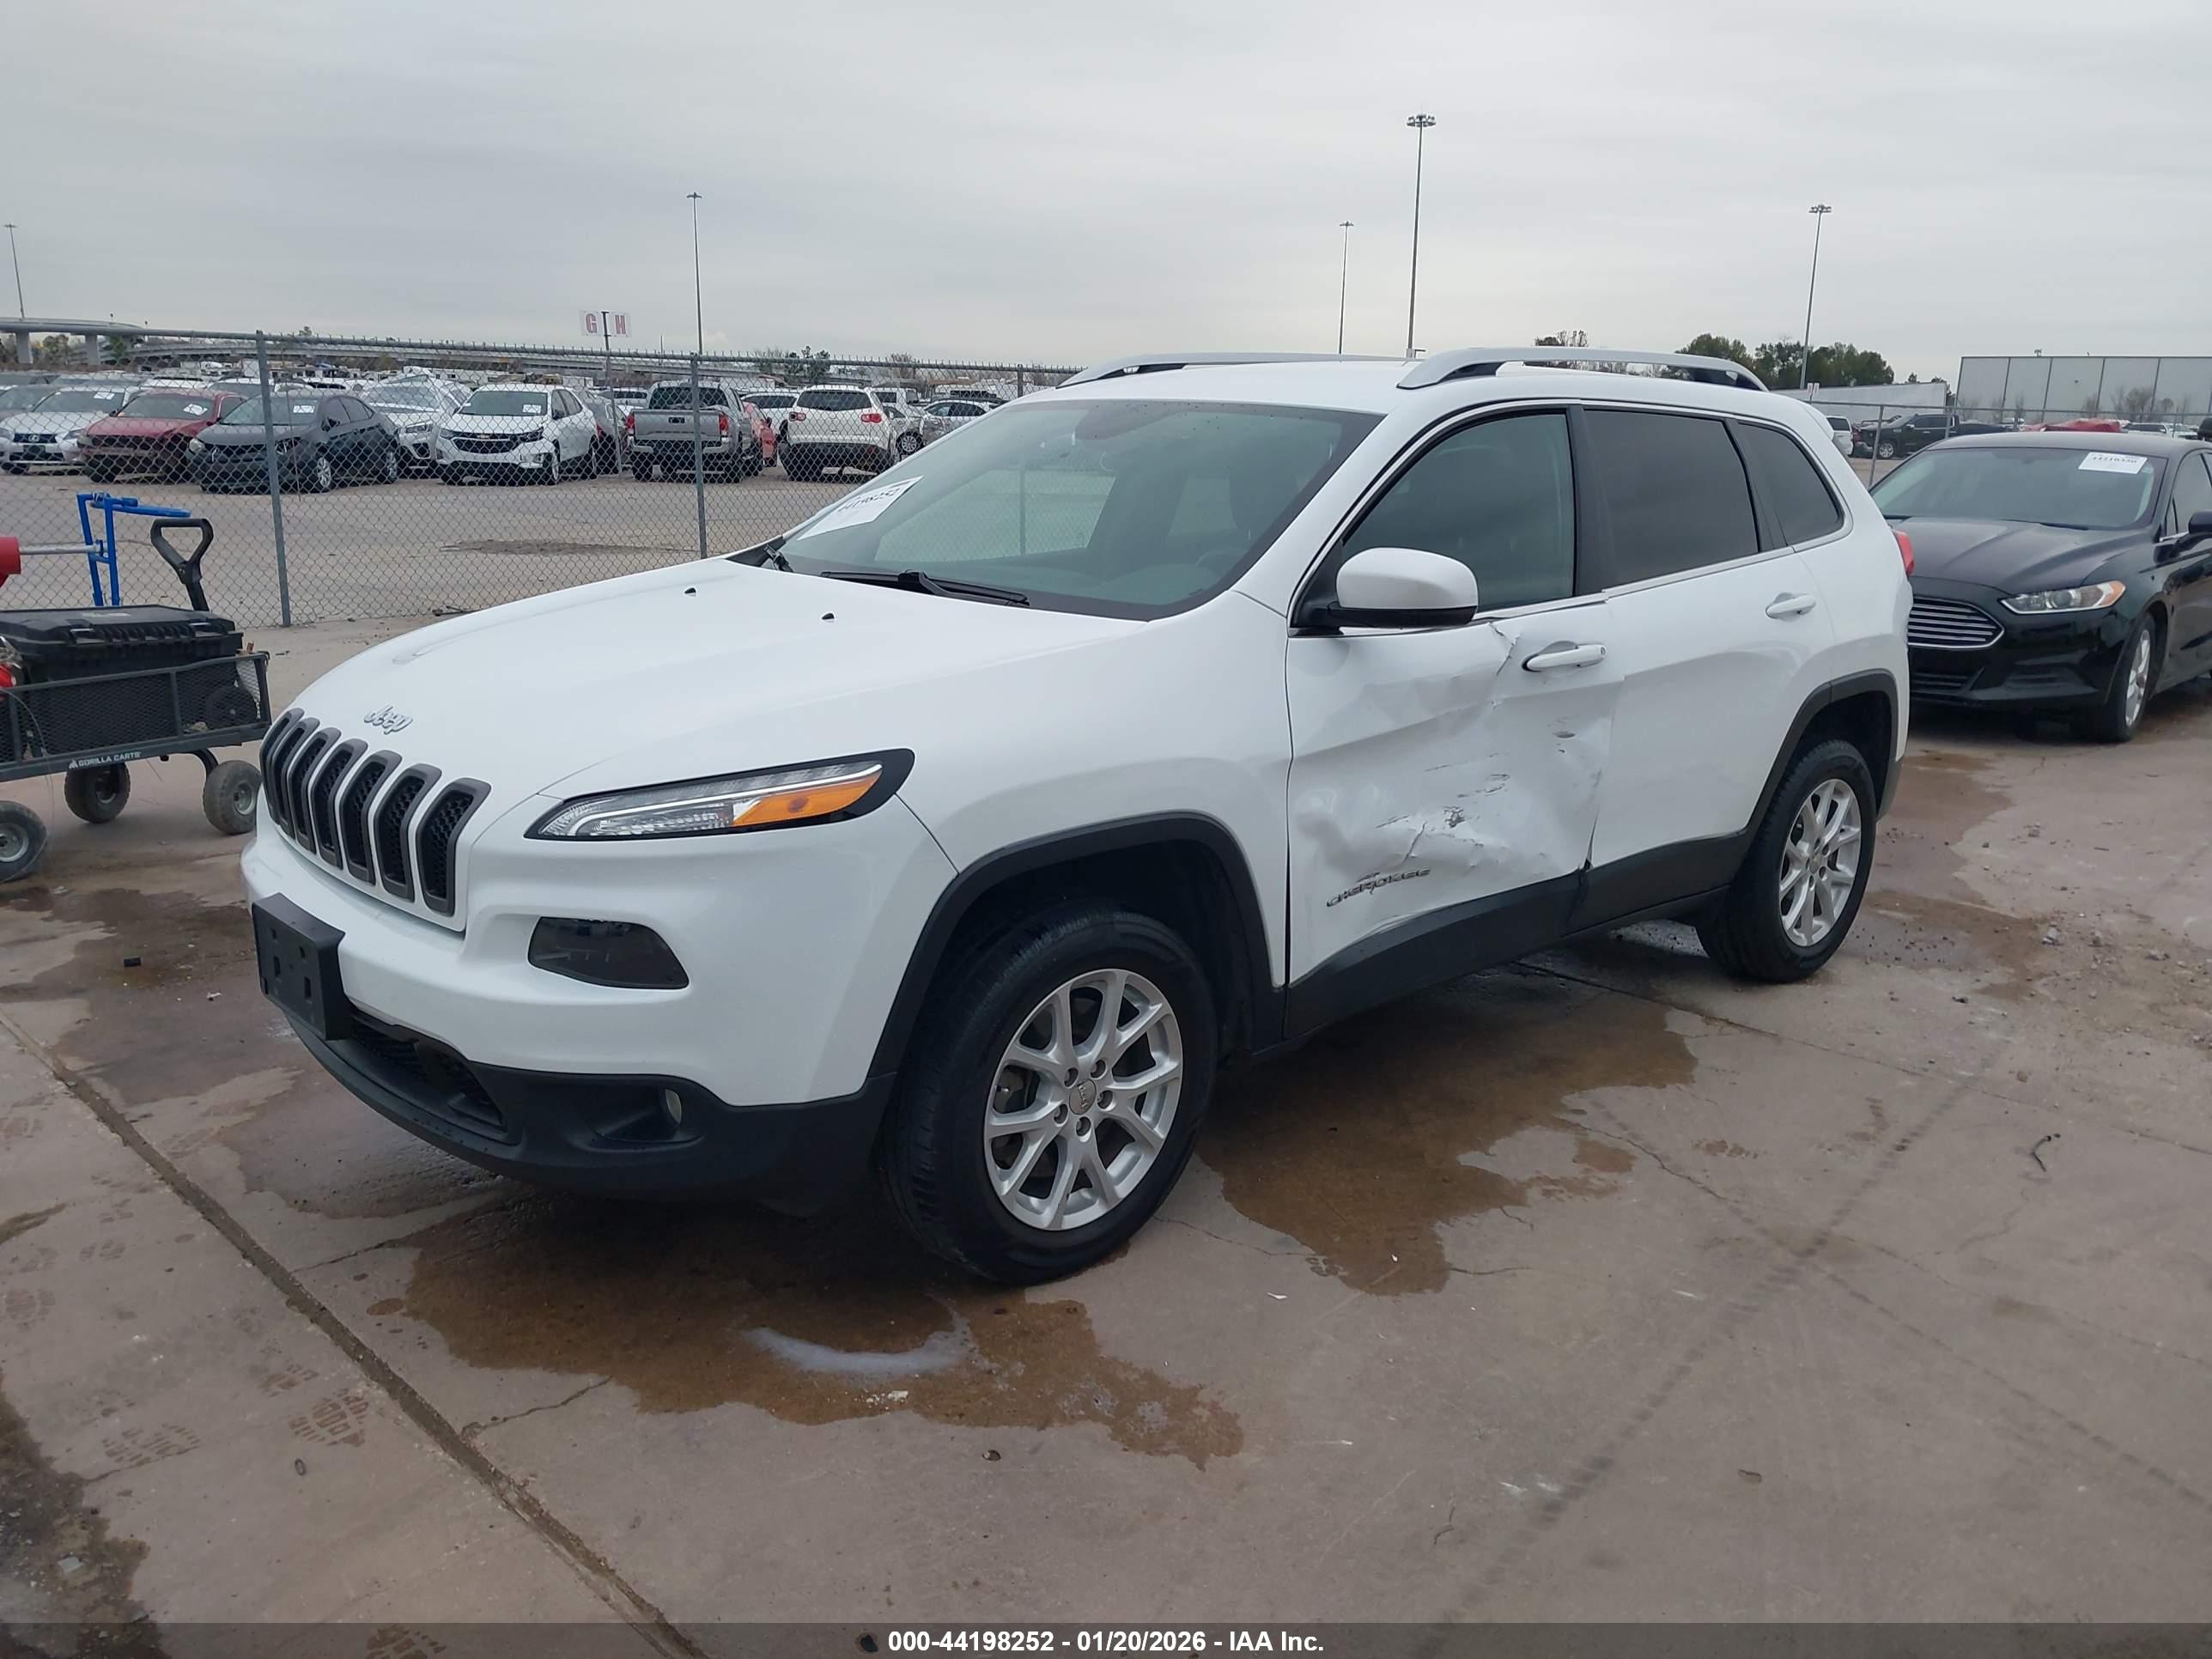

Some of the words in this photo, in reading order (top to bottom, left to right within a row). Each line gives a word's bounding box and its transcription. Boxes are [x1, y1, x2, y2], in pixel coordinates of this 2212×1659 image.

[586, 313, 598, 333] G
[614, 314, 626, 334] H
[363, 704, 413, 735] Jeep
[78, 756, 112, 767] GORILLA
[113, 751, 140, 762] CARTS
